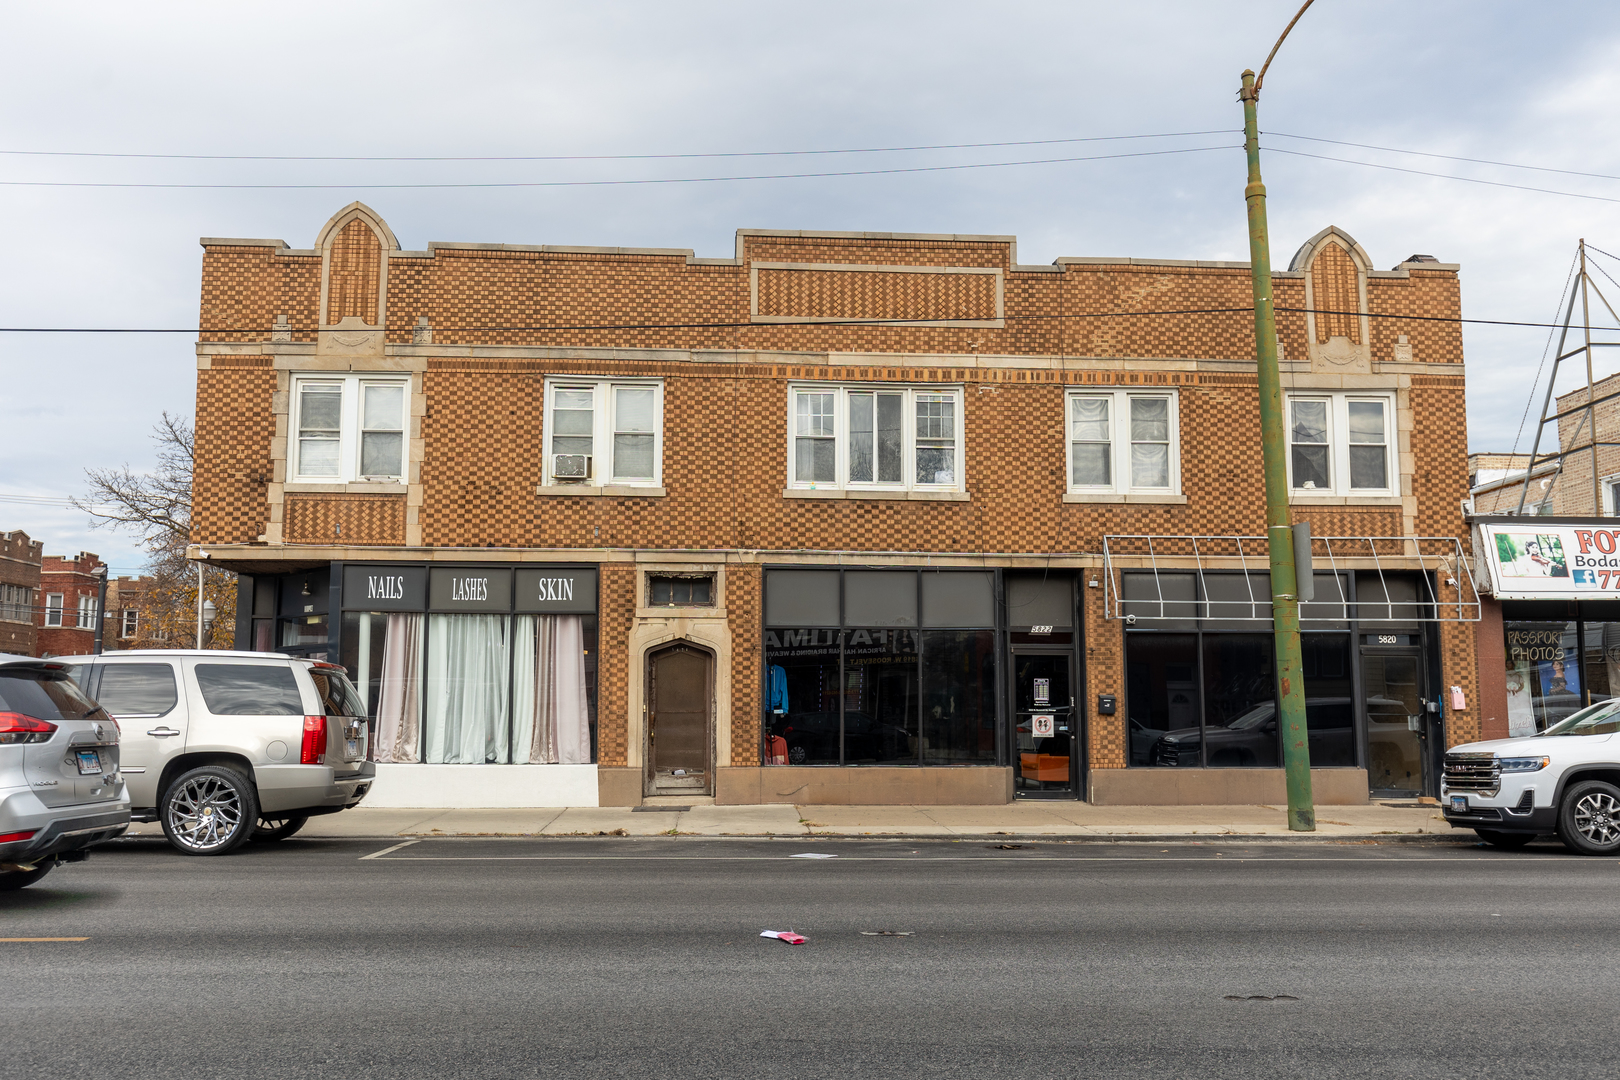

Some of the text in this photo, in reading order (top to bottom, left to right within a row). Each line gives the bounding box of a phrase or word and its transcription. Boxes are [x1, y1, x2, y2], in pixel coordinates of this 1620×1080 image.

[1575, 555, 1620, 567] Boda
[367, 576, 404, 599] NAILS
[452, 578, 488, 601] LASHES
[538, 578, 574, 601] SKIN
[1378, 634, 1397, 644] 5820
[1507, 631, 1565, 645] PASSPORT
[1511, 646, 1565, 660] PHOTOS
